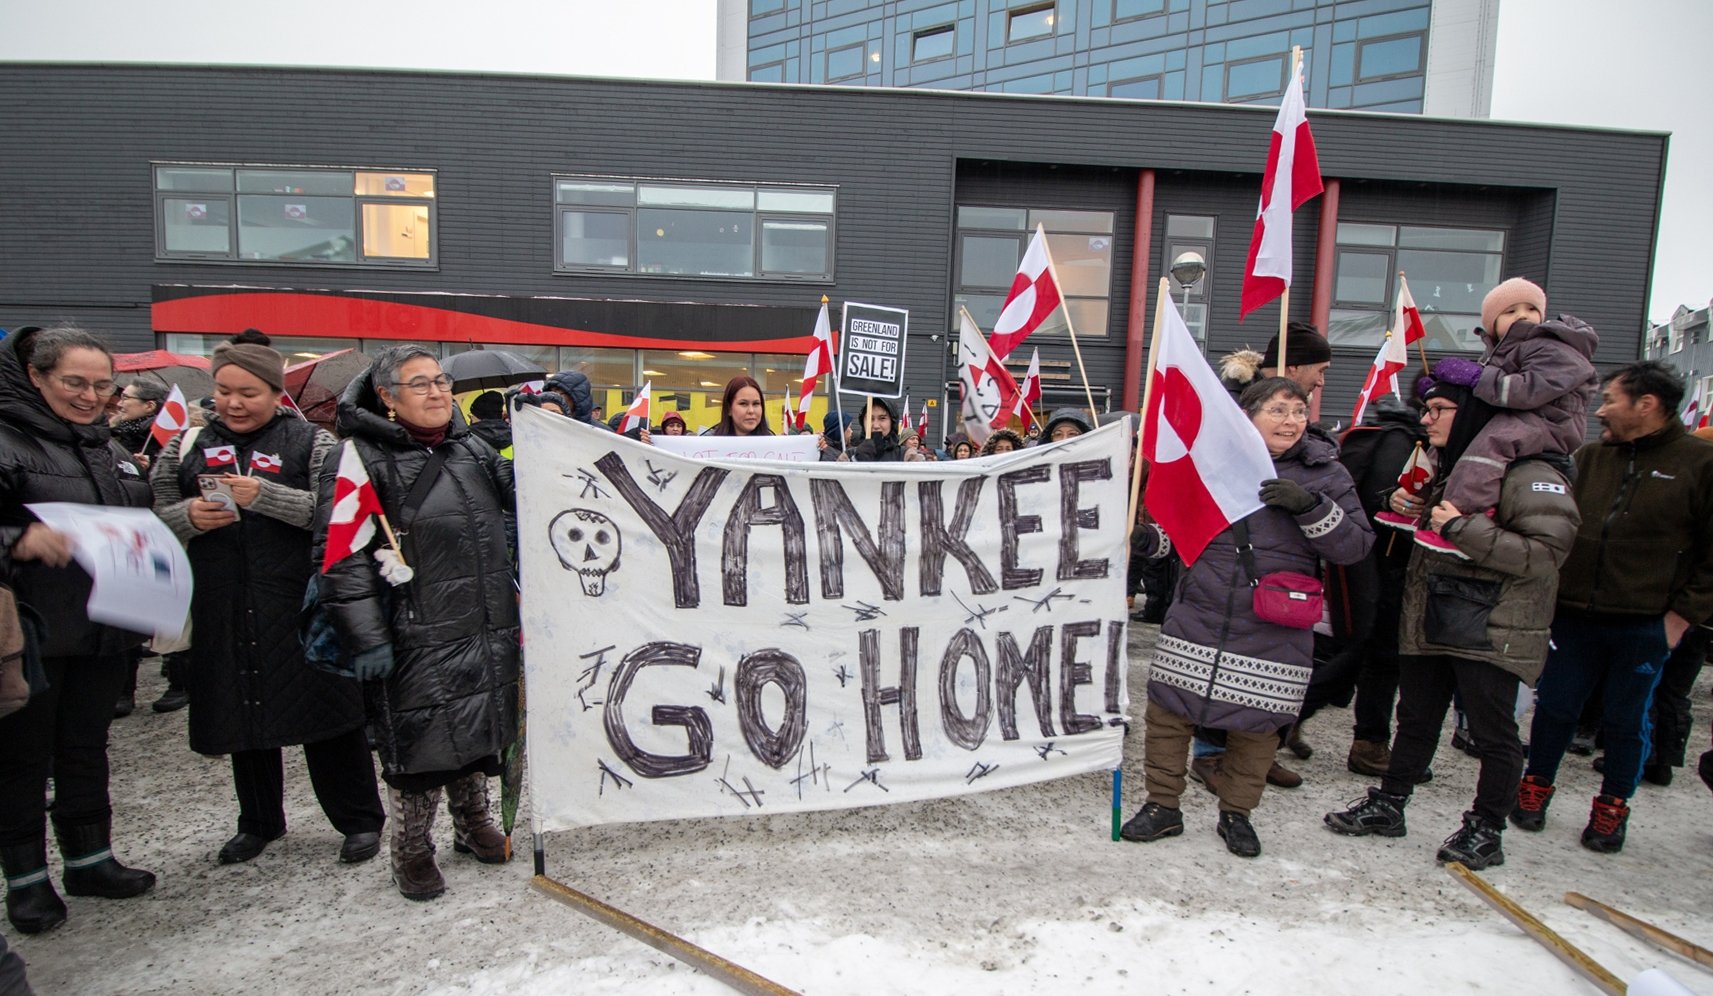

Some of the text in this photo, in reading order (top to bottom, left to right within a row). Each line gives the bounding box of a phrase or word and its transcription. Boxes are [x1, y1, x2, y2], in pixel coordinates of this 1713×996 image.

[852, 320, 898, 337] GREENLAND
[850, 337, 897, 353] IS NOT FOR
[848, 354, 895, 380] SALE!
[594, 450, 1112, 609] YANKEE
[603, 618, 1124, 778] GO HOME!
